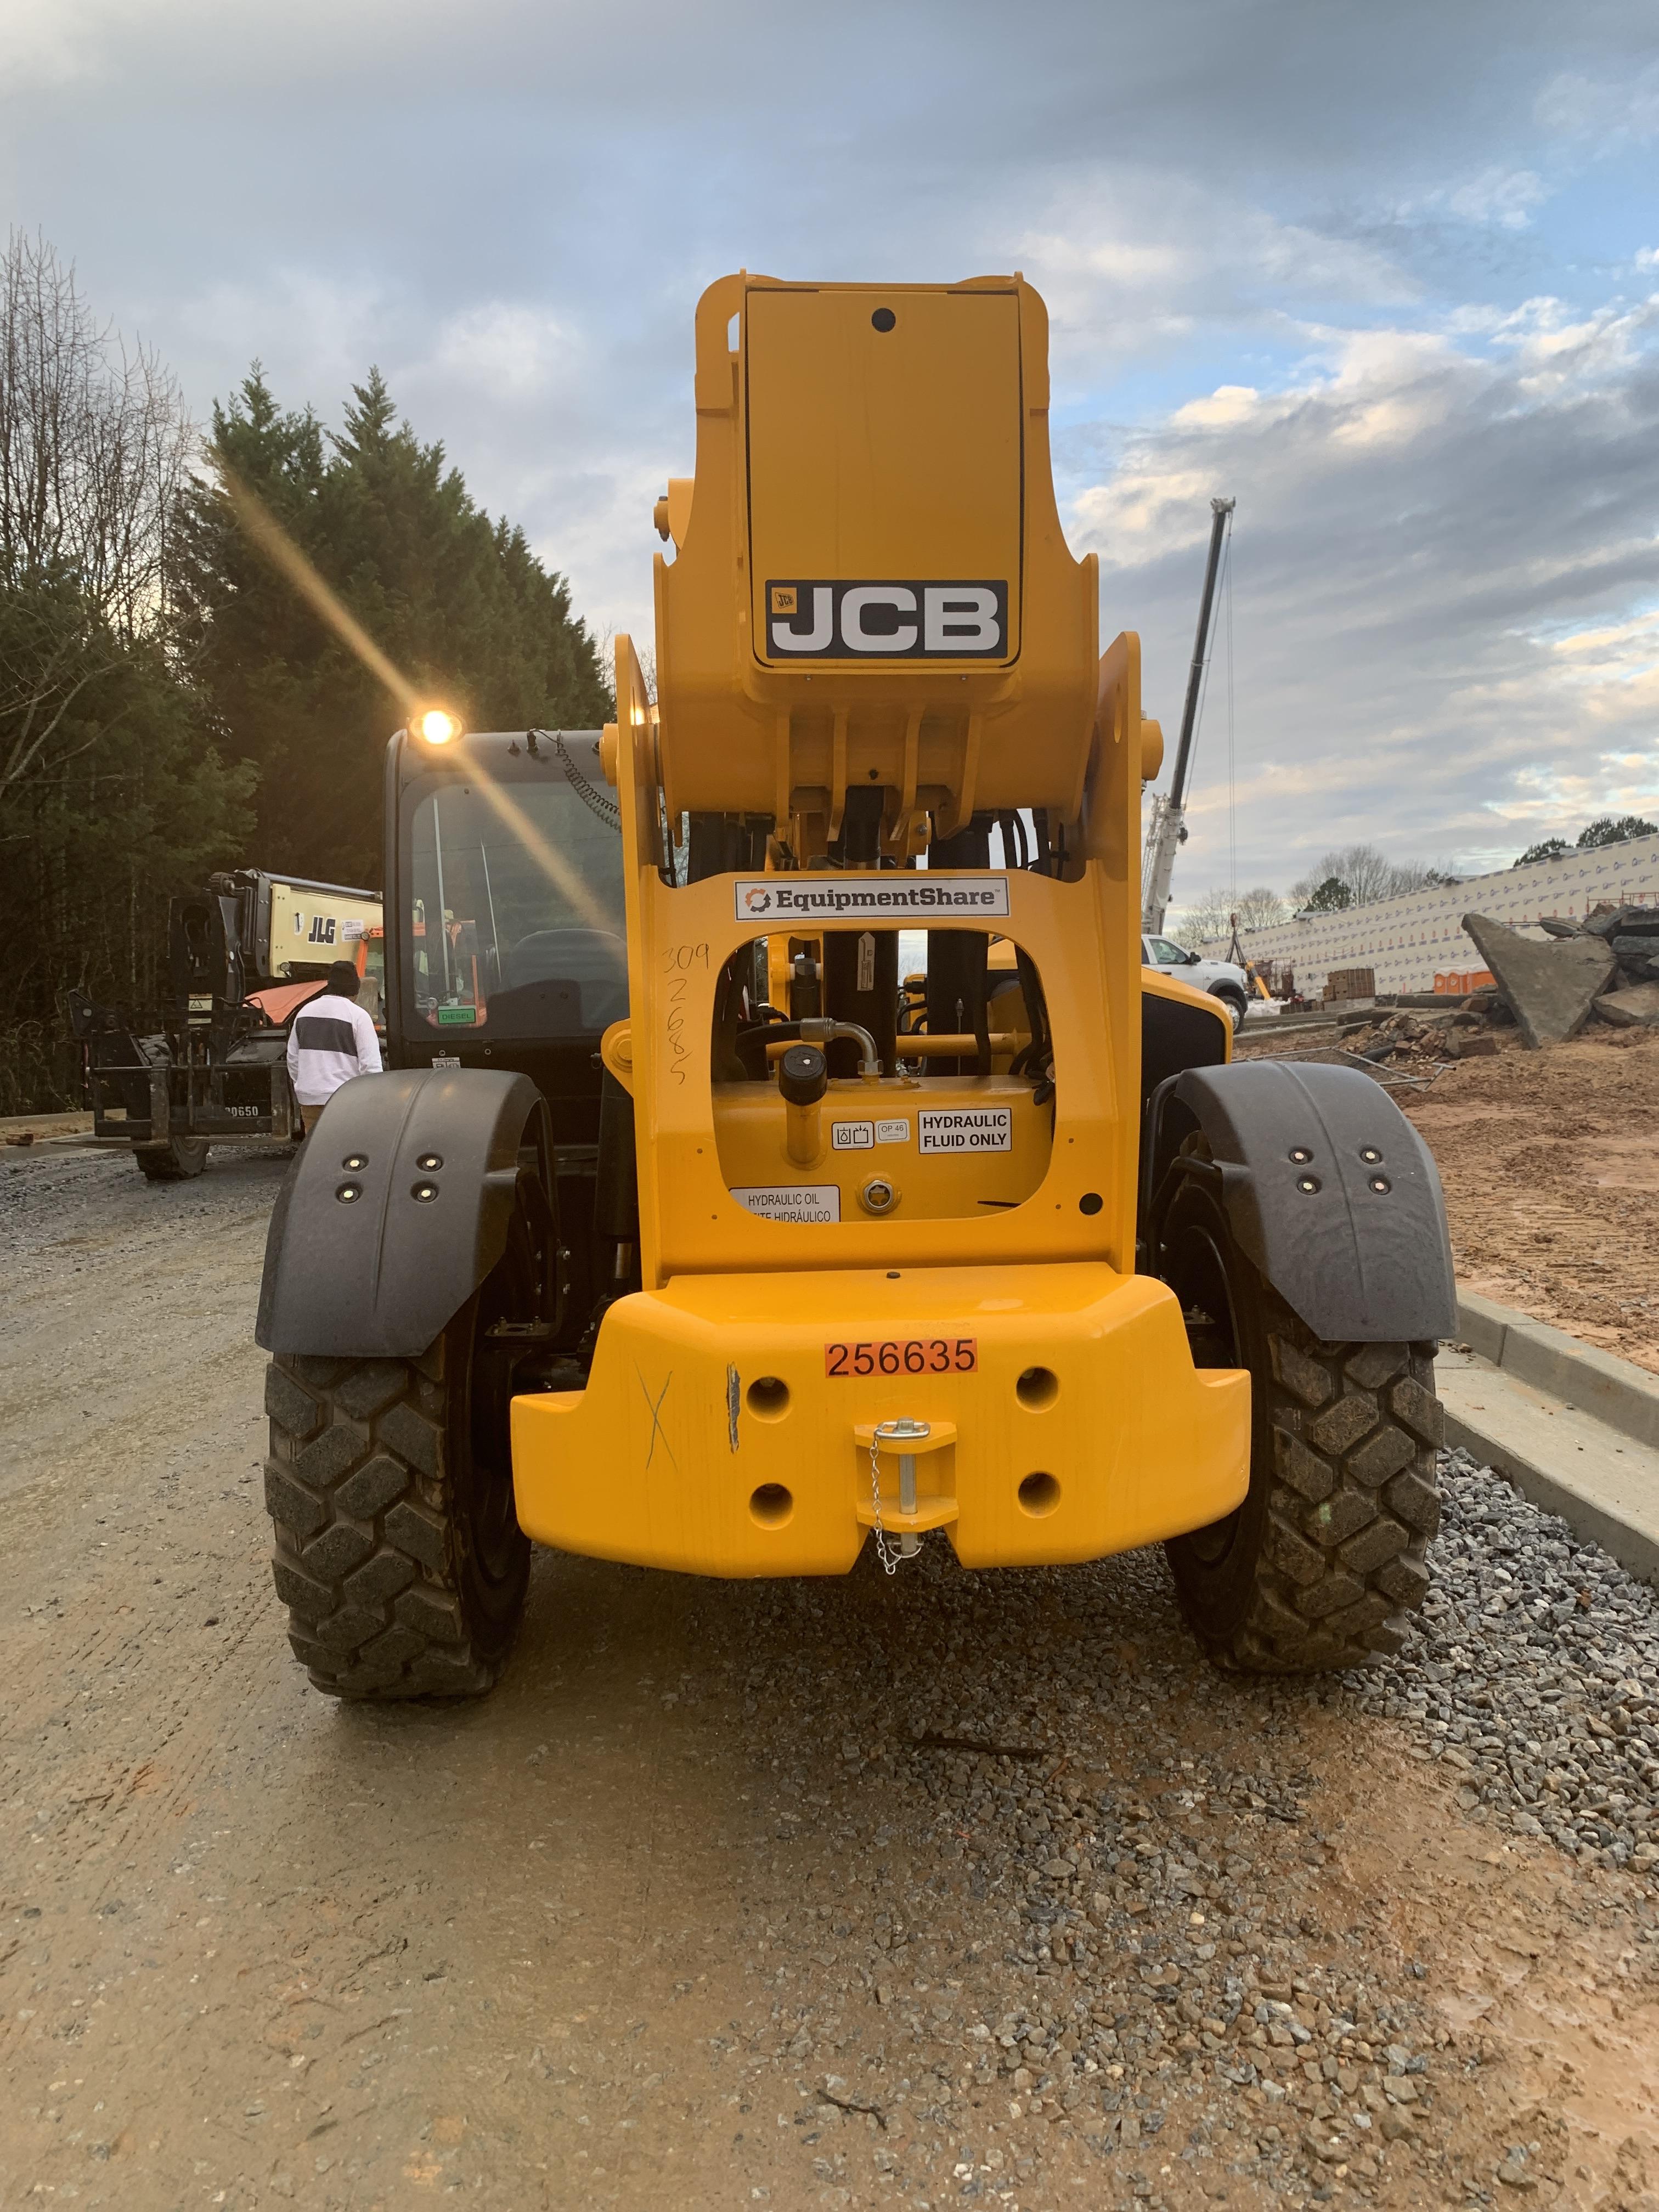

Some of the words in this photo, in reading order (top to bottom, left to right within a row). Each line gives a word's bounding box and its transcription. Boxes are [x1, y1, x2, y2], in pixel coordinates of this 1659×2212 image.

[772, 587, 1000, 651] JCB
[776, 888, 995, 911] EquipmentShare
[308, 917, 336, 944] JLG
[662, 943, 709, 973] 309
[923, 1114, 1007, 1128] HYDRAULIC
[924, 1135, 965, 1147] FLUID
[969, 1133, 1007, 1146] ONLY
[748, 1194, 802, 1206] HYDRAULIC
[805, 1193, 820, 1204] OIL
[828, 1339, 975, 1376] 256635
